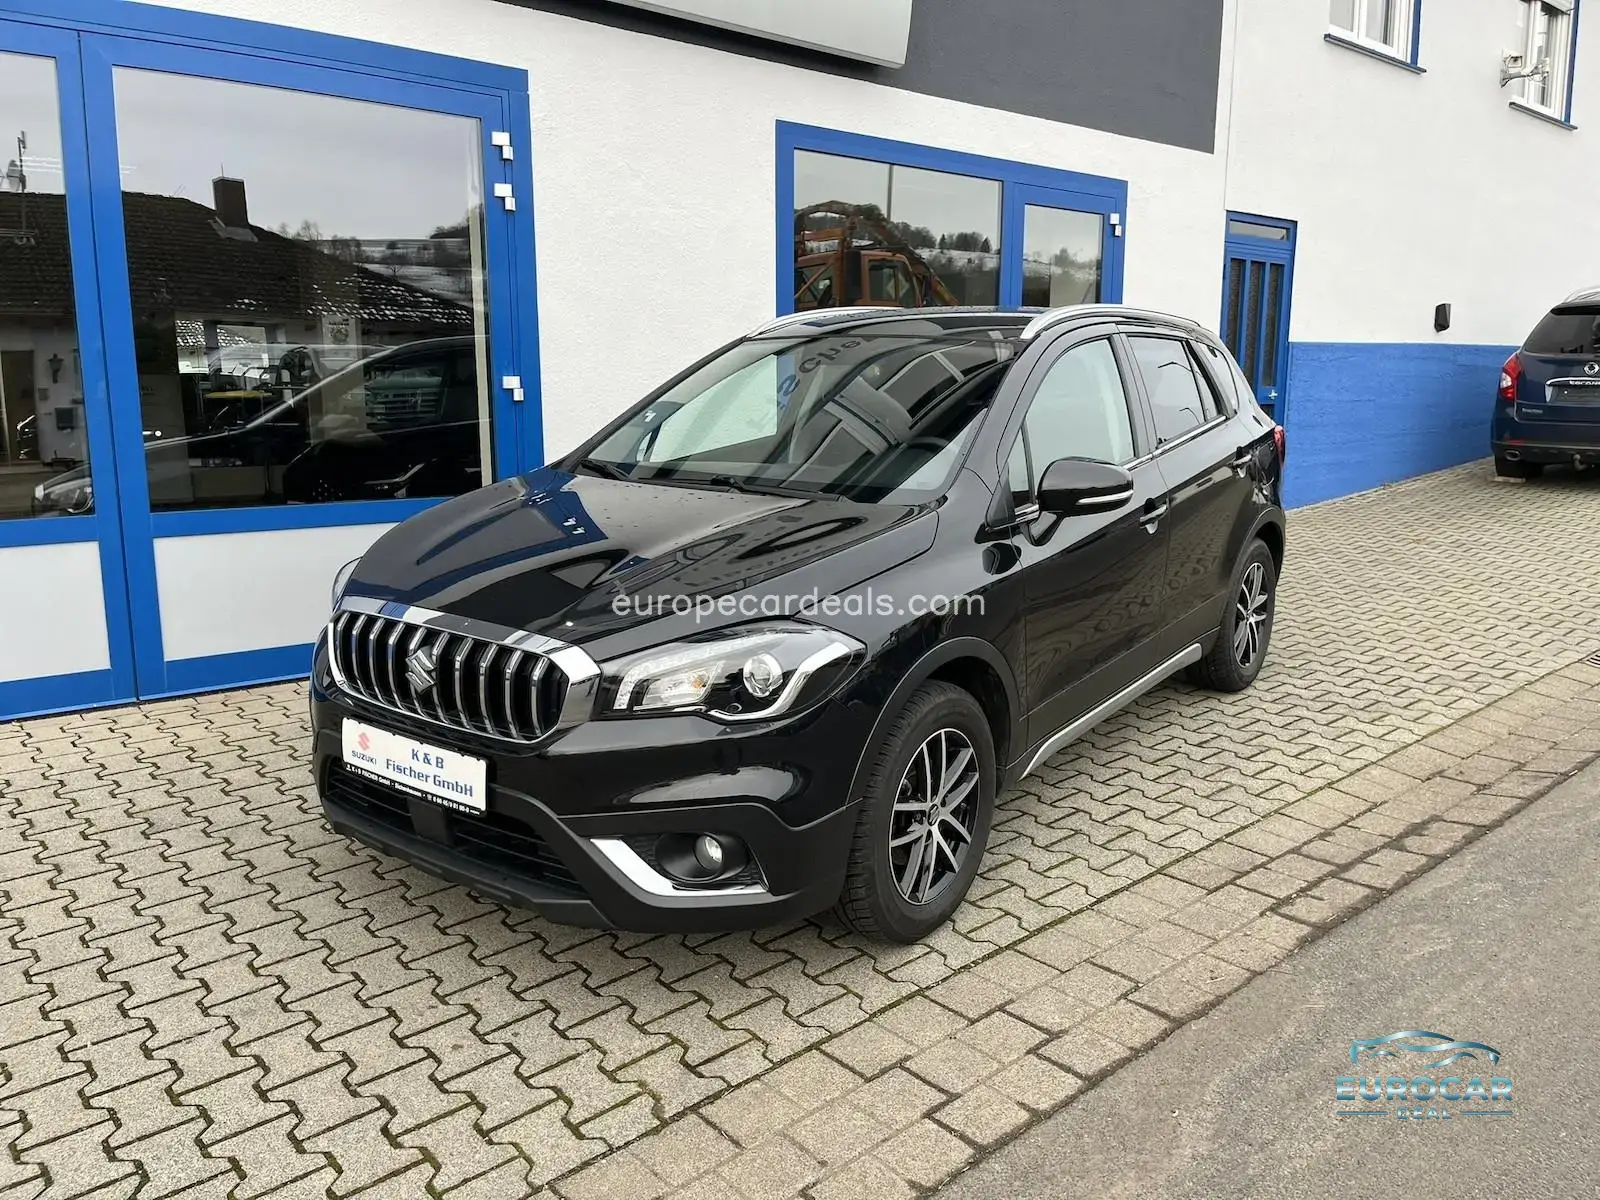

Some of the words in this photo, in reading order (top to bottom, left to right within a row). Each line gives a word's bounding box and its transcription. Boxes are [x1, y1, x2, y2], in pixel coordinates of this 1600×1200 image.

[351, 750, 377, 765] SUZUKI
[411, 748, 420, 762] K
[422, 753, 433, 766] &
[435, 756, 445, 769] B
[386, 758, 431, 783] Fischer
[433, 771, 474, 798] GmbH
